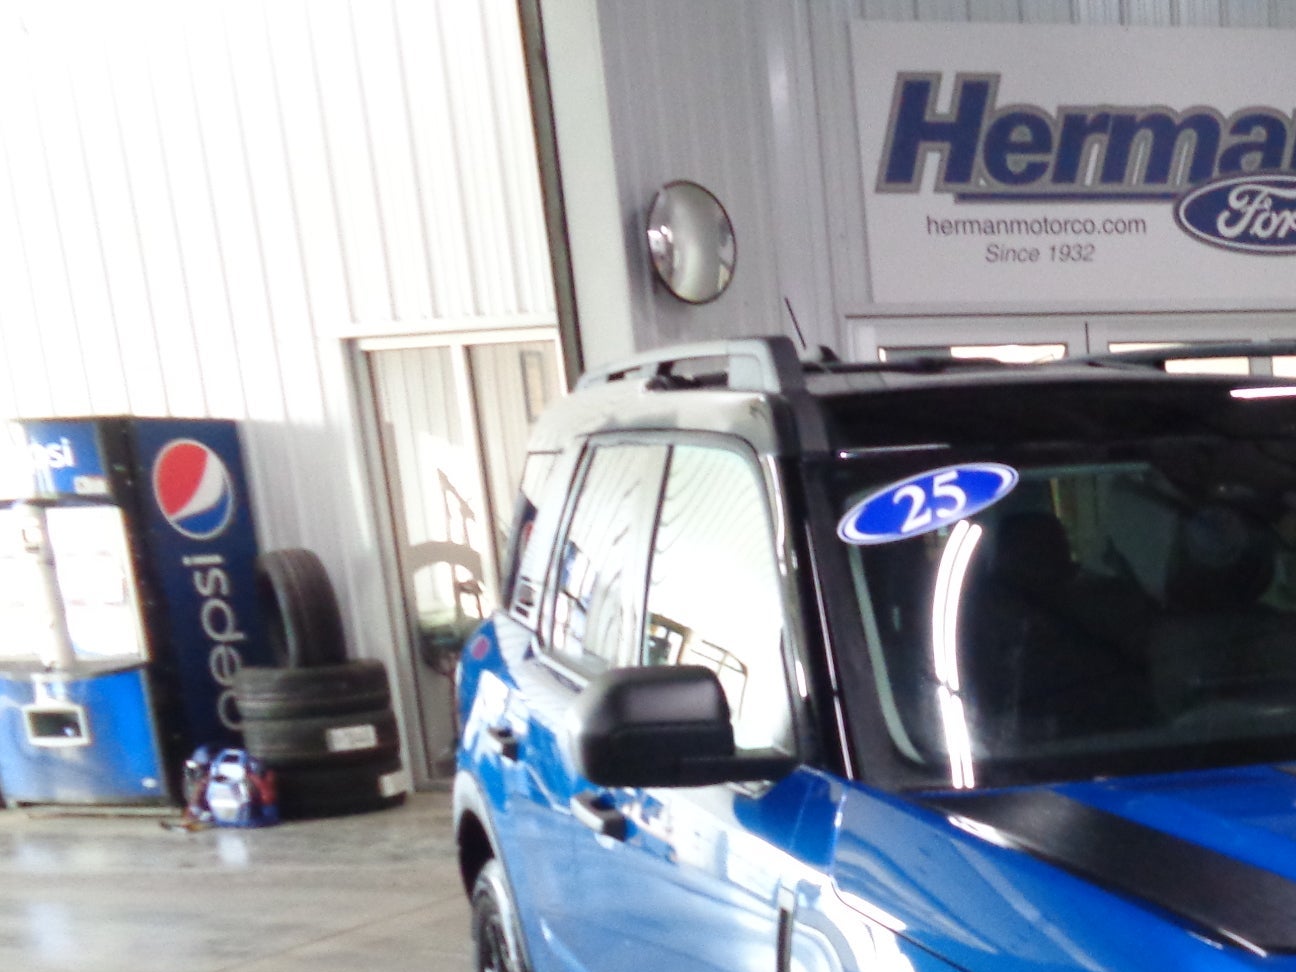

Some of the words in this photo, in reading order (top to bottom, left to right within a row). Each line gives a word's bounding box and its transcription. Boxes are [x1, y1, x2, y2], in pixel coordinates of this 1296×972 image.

[925, 214, 1147, 238] hermanmotorco.com
[985, 244, 1041, 264] Since
[1048, 245, 1096, 263] 1932
[892, 471, 968, 533] 25
